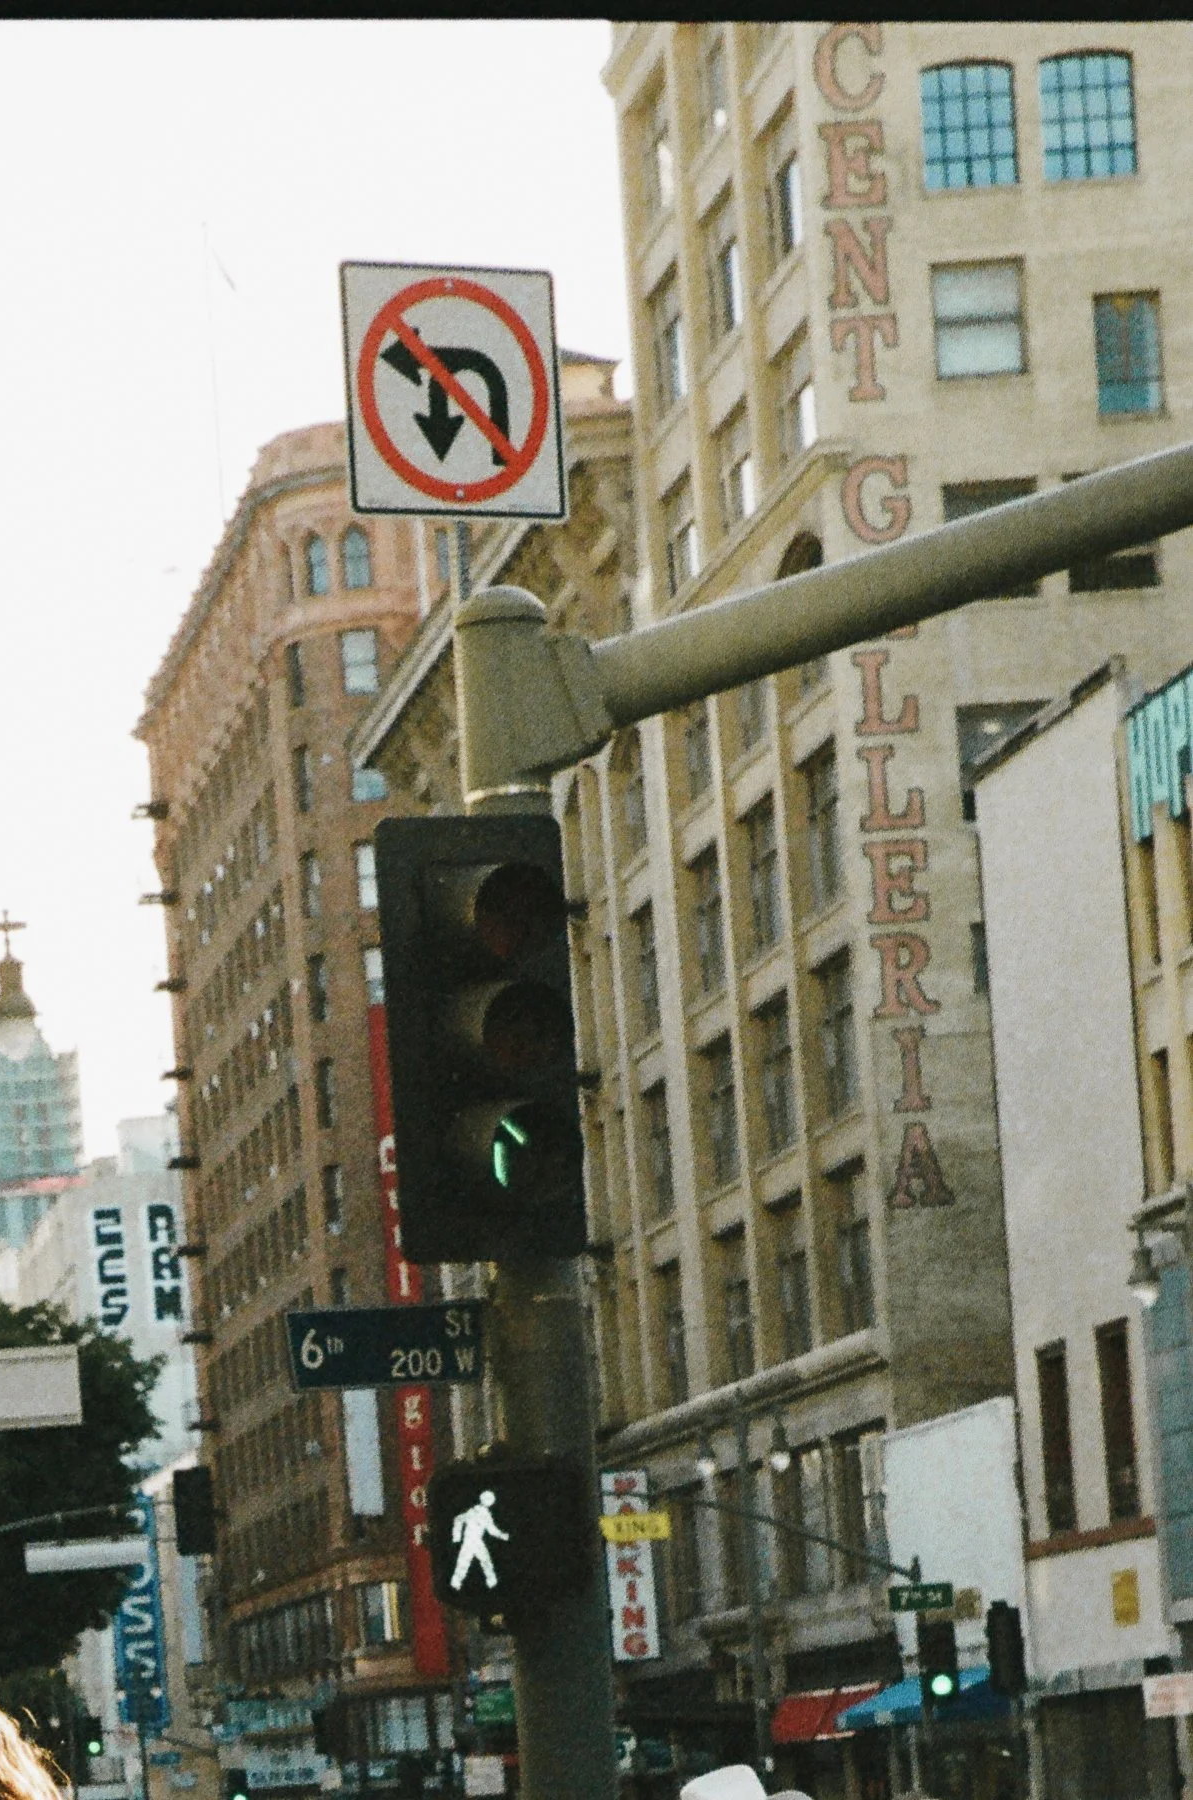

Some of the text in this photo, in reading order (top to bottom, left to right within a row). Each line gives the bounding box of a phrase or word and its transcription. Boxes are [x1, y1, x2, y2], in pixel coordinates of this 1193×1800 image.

[840, 453, 956, 1209] GLLERIA
[301, 1309, 472, 1370] 6th St
[390, 1346, 475, 1378] 200 W
